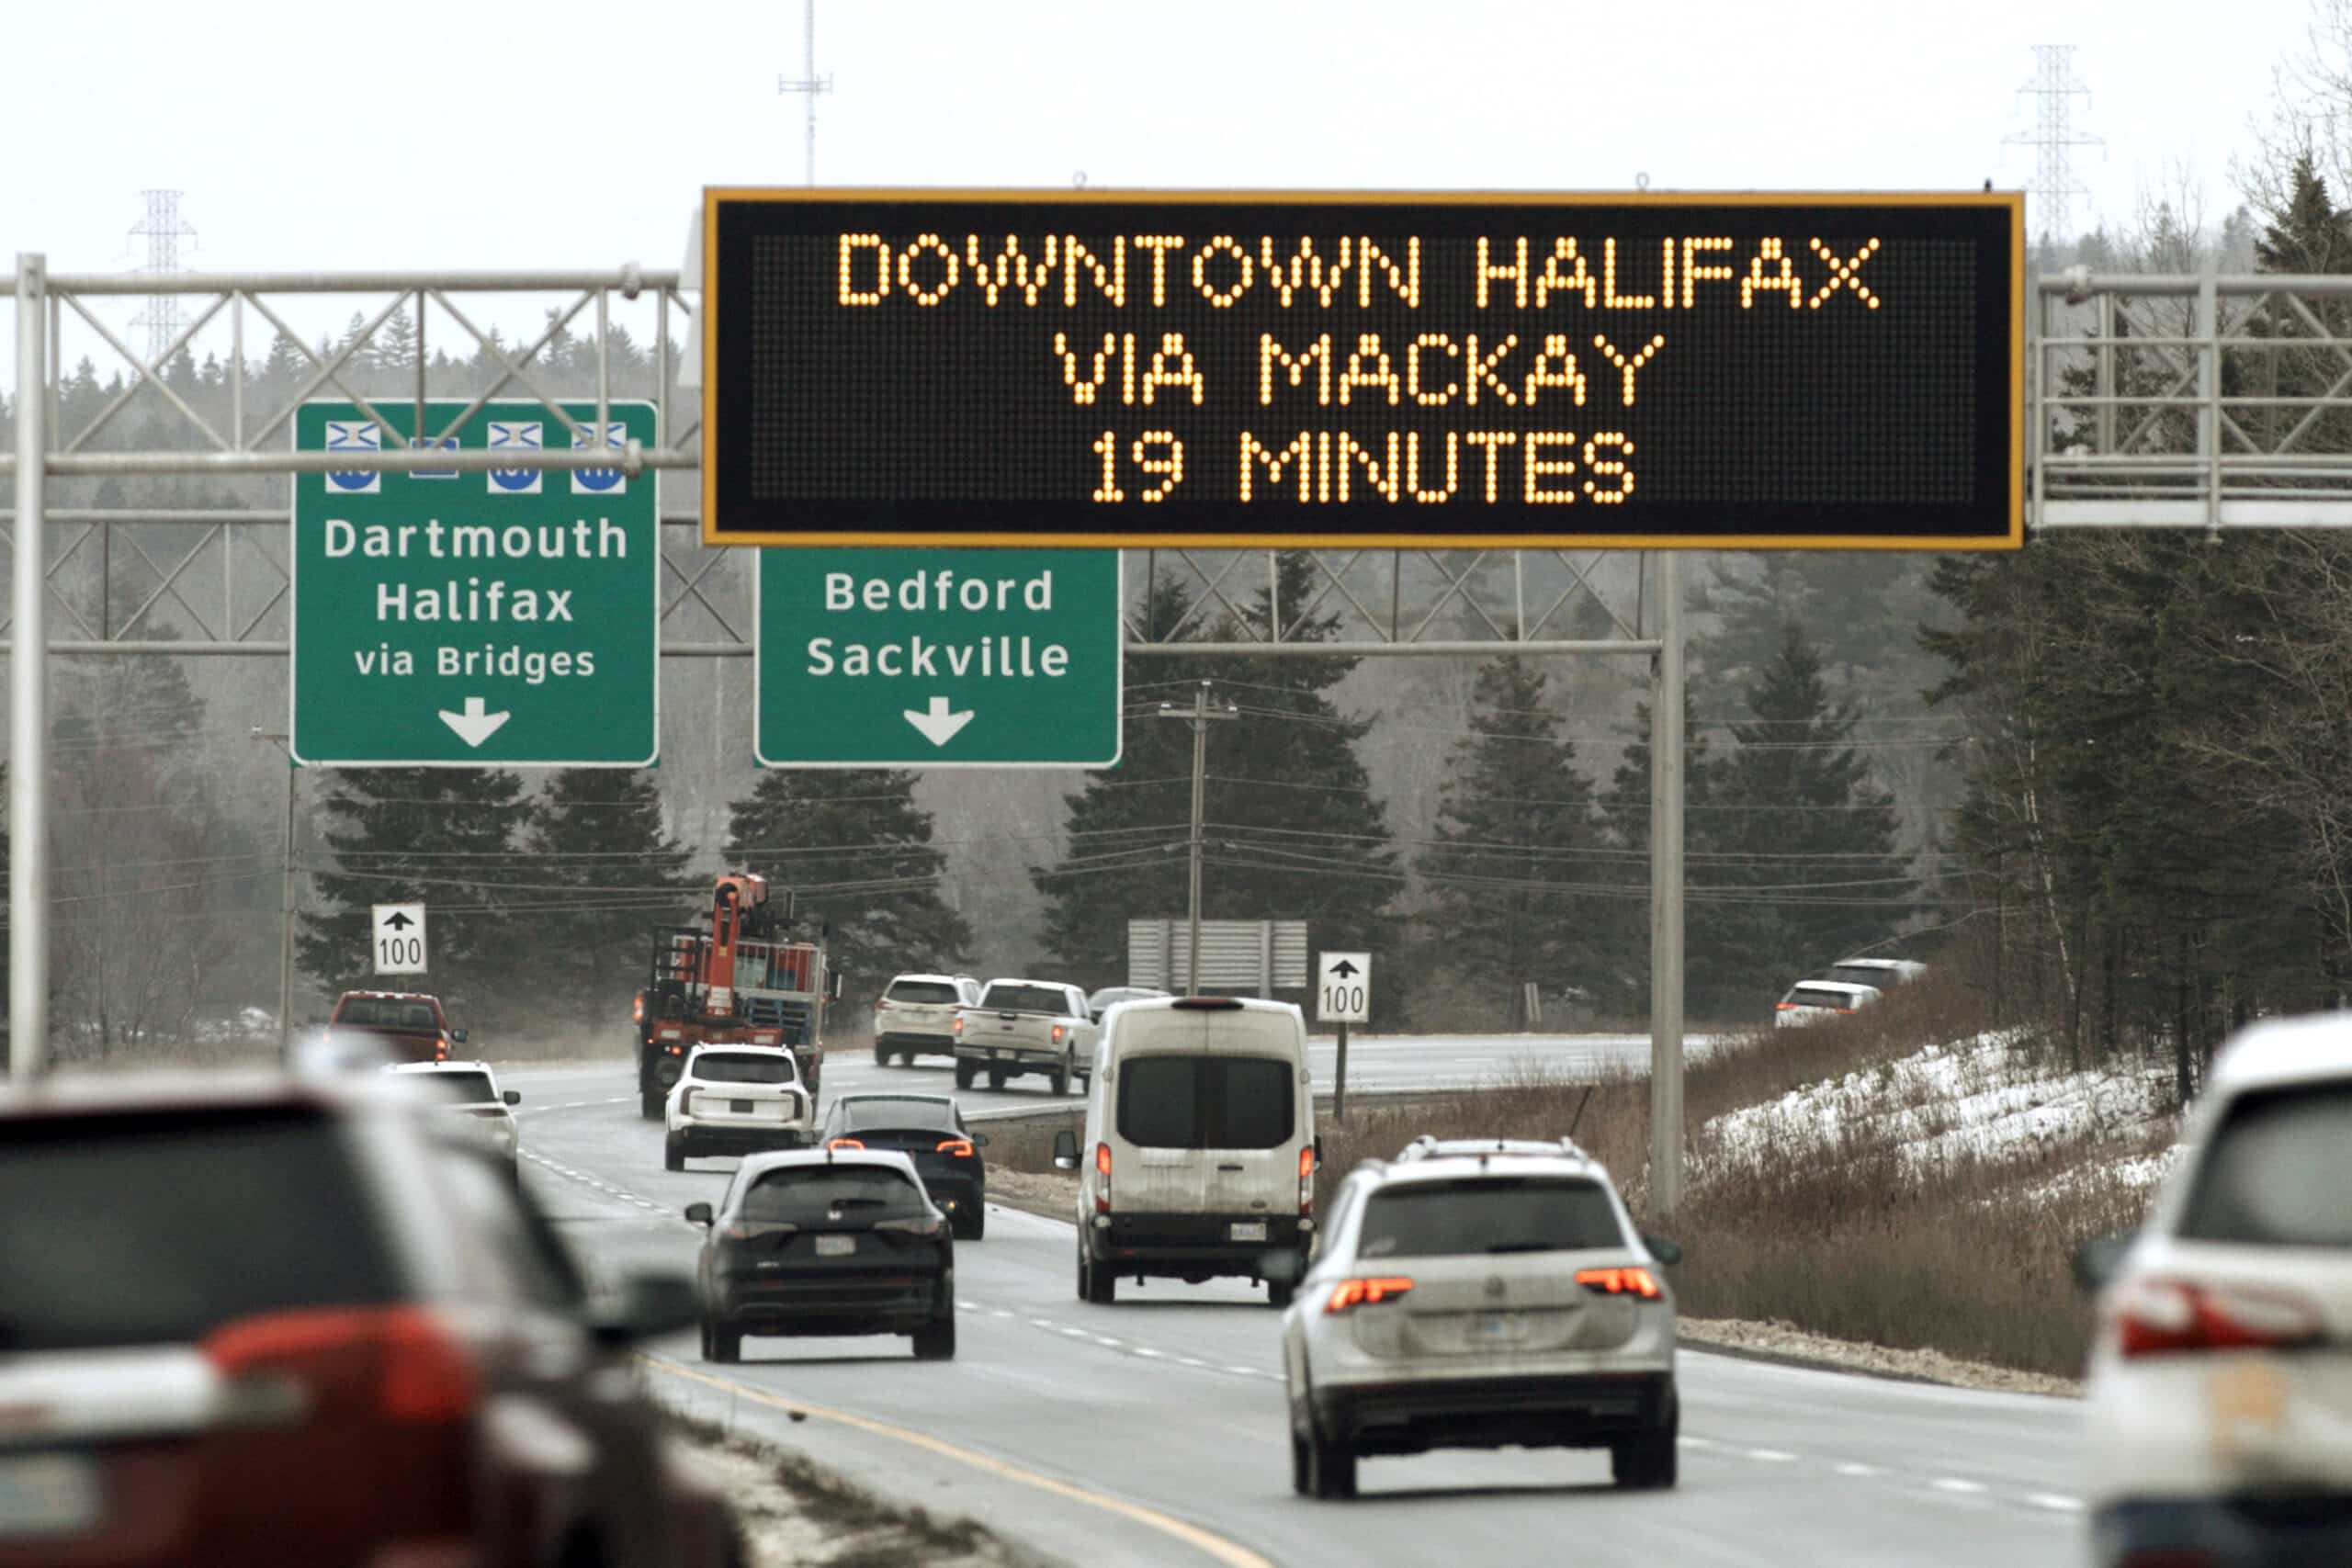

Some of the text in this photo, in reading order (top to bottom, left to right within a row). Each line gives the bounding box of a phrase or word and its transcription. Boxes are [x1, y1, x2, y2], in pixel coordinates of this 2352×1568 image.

[839, 233, 1882, 310] DOWNTOWN HALIFAX
[1054, 332, 1665, 406] VIA MACKAY
[1093, 430, 1635, 504] 19 MINUTES
[324, 517, 627, 558] Dartmouth
[377, 577, 573, 622] Halifax
[825, 570, 1052, 611] Bedford
[355, 642, 594, 684] via Bridges
[808, 636, 1069, 677] Sackville
[379, 937, 422, 965] 100
[1324, 986, 1363, 1014] 100
